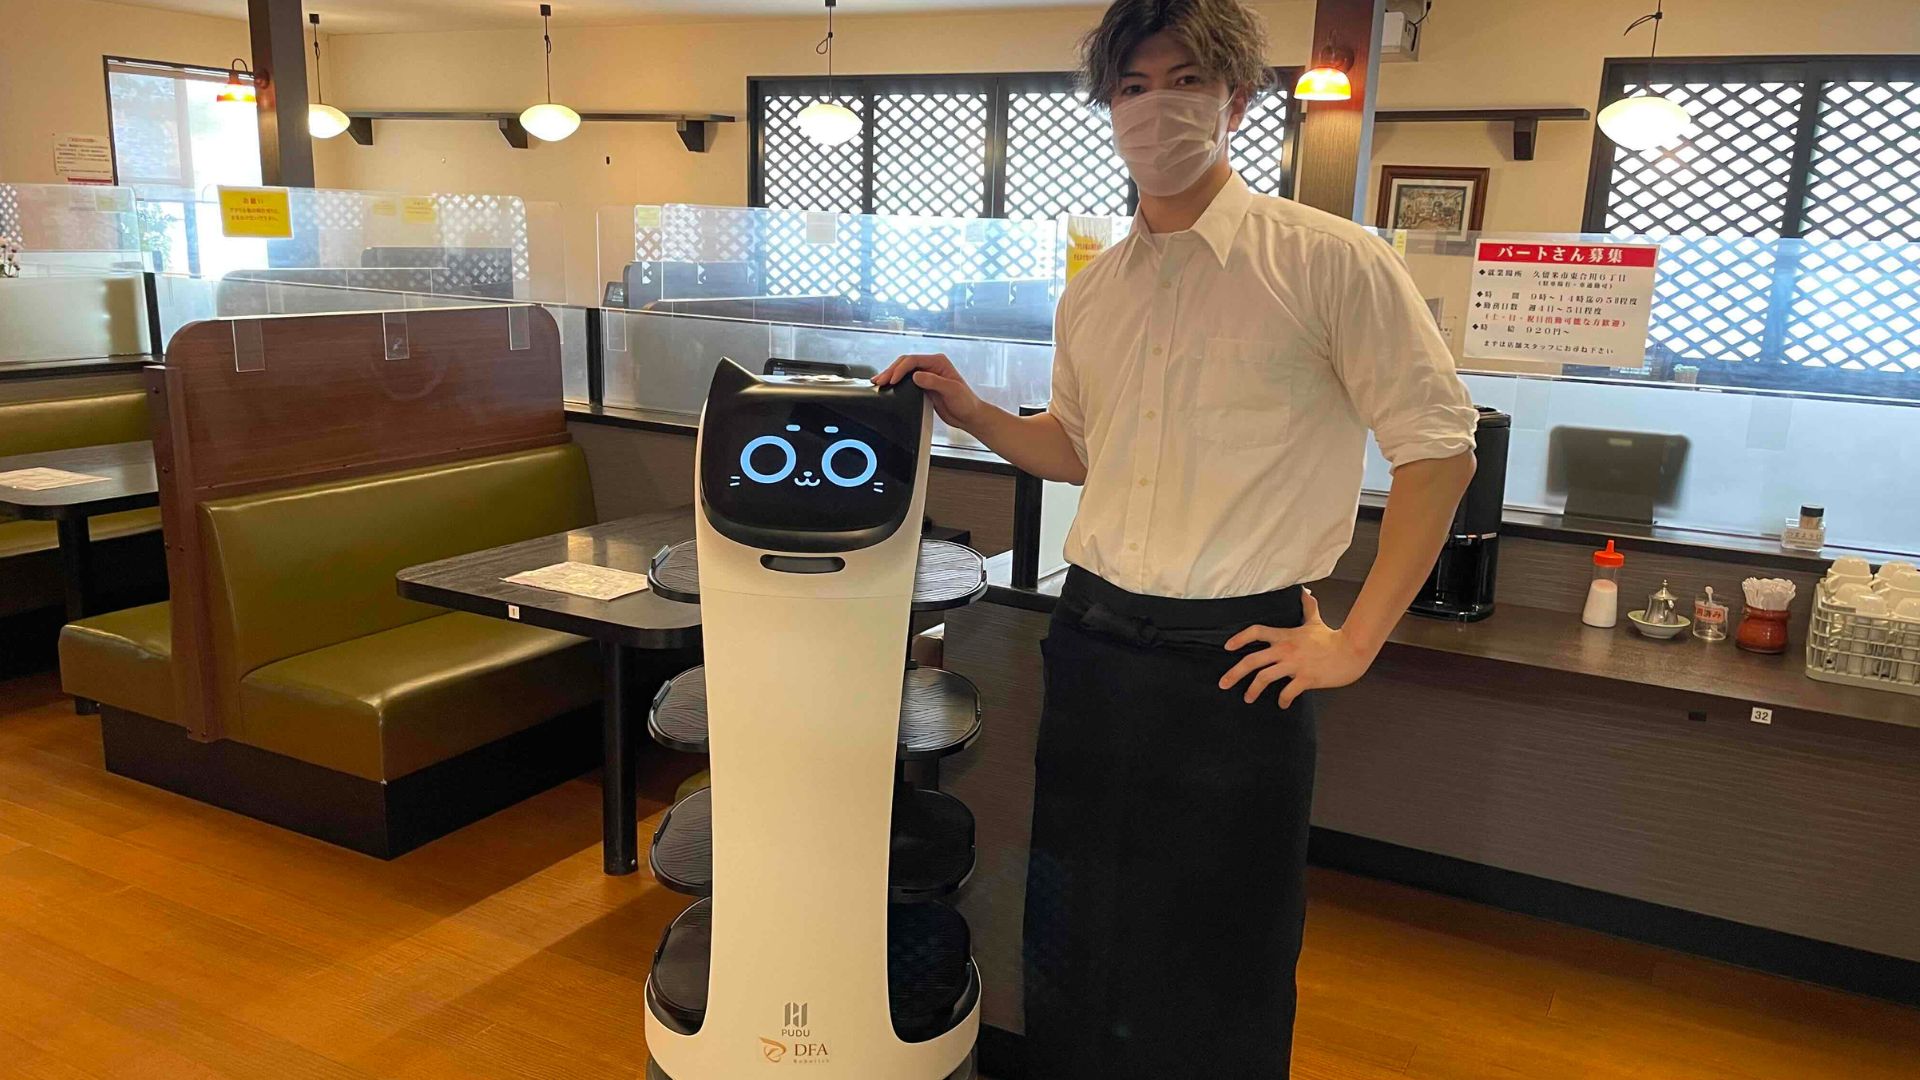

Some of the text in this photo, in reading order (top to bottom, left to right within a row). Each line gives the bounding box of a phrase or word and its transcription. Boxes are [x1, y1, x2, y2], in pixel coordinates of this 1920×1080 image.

[1497, 246, 1624, 264] パートさん募集
[1483, 302, 1518, 311] 勤務日数
[1754, 710, 1769, 721] 32
[781, 1028, 811, 1037] PUDU
[794, 1043, 829, 1056] DFA
